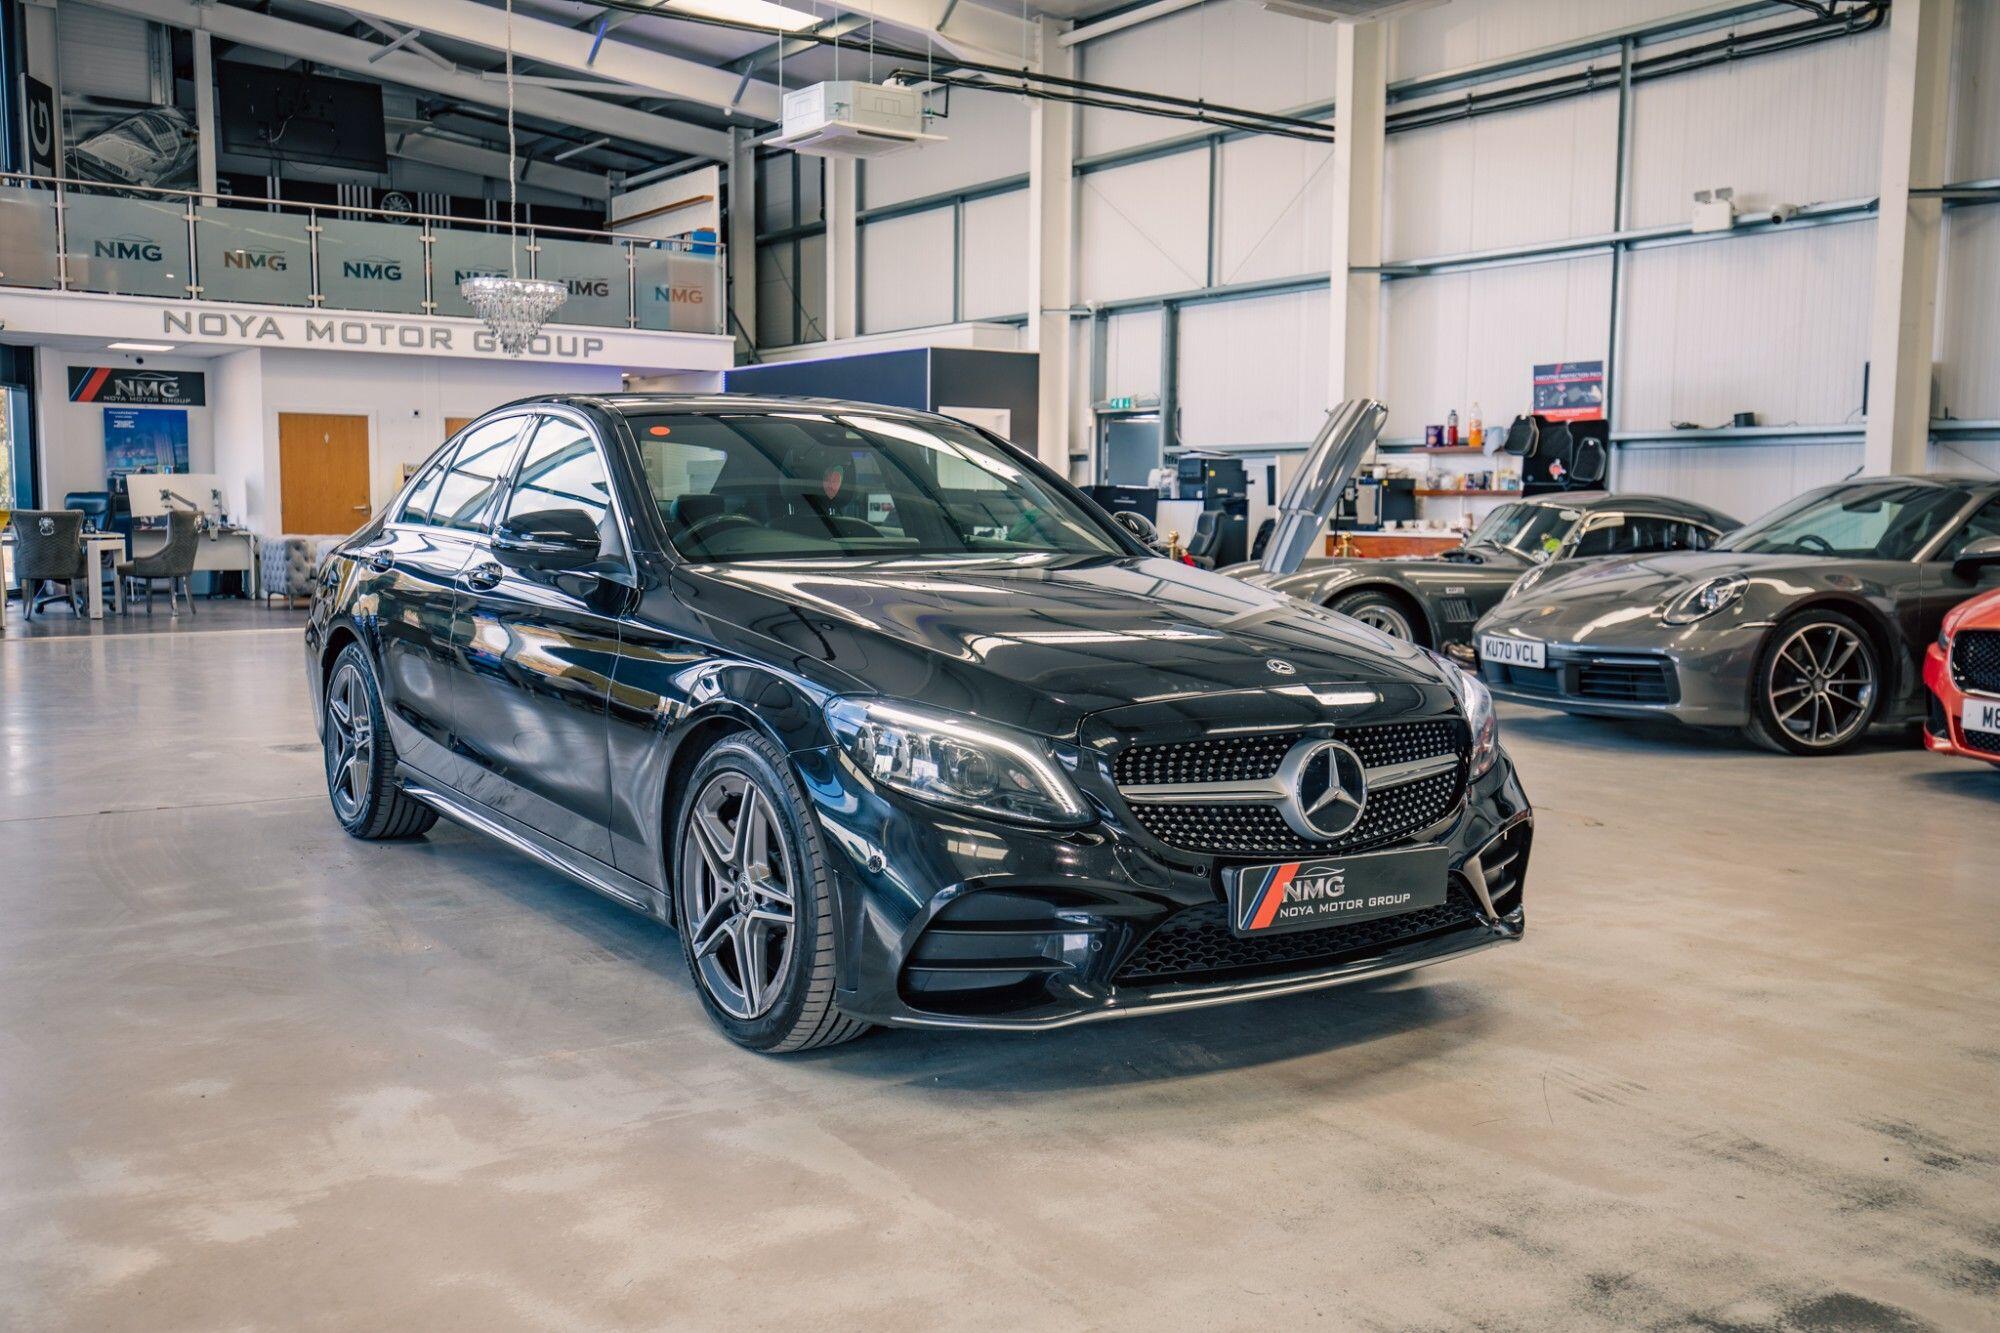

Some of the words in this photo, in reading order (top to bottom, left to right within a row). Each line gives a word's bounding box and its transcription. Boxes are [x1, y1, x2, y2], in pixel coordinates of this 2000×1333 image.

[95, 240, 162, 262] NMG
[224, 251, 287, 271] NMG
[343, 261, 402, 281] NMG
[655, 286, 703, 304] NMG
[163, 309, 284, 340] NOYA
[306, 319, 453, 350] MOTOR
[473, 331, 603, 357] GOUP
[114, 379, 180, 397] NMG
[129, 395, 159, 403] MOTOR
[1485, 640, 1512, 660] KU70
[1515, 644, 1538, 663] VCL
[1282, 876, 1345, 903] NMG
[1279, 904, 1314, 919] NOYA
[1319, 899, 1363, 913] MOTOR
[1368, 893, 1411, 907] GROUP
